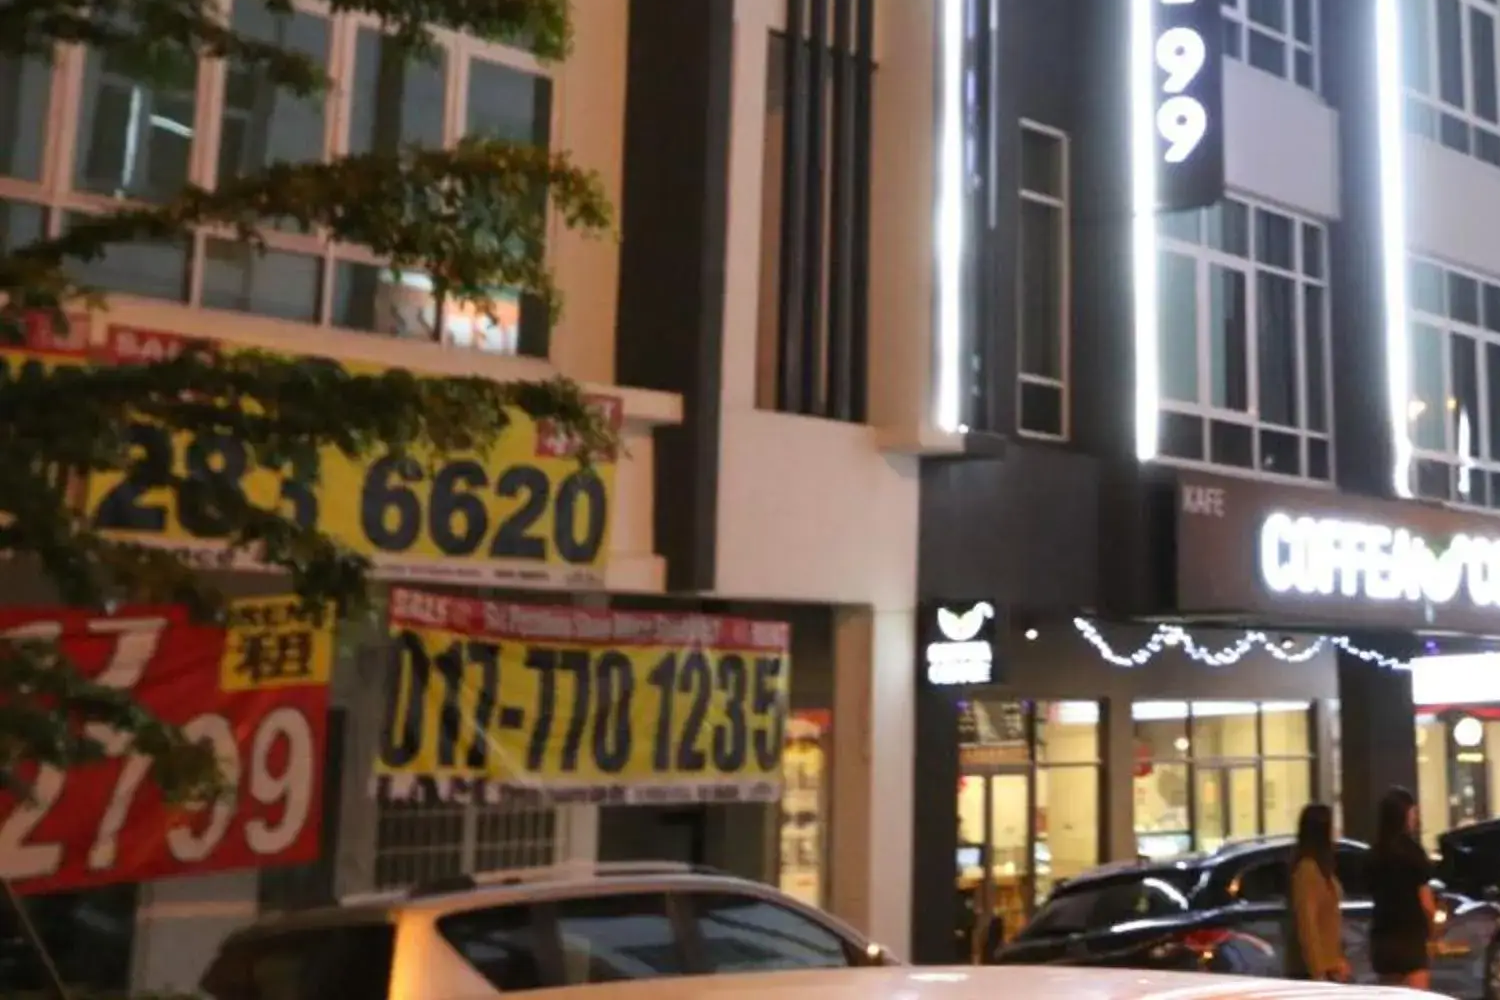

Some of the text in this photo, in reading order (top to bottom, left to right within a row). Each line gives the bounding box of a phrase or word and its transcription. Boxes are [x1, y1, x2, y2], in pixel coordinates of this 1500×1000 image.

[1156, 26, 1206, 163] 99
[361, 448, 607, 564] 6620
[379, 630, 786, 774] 017-770 1235
